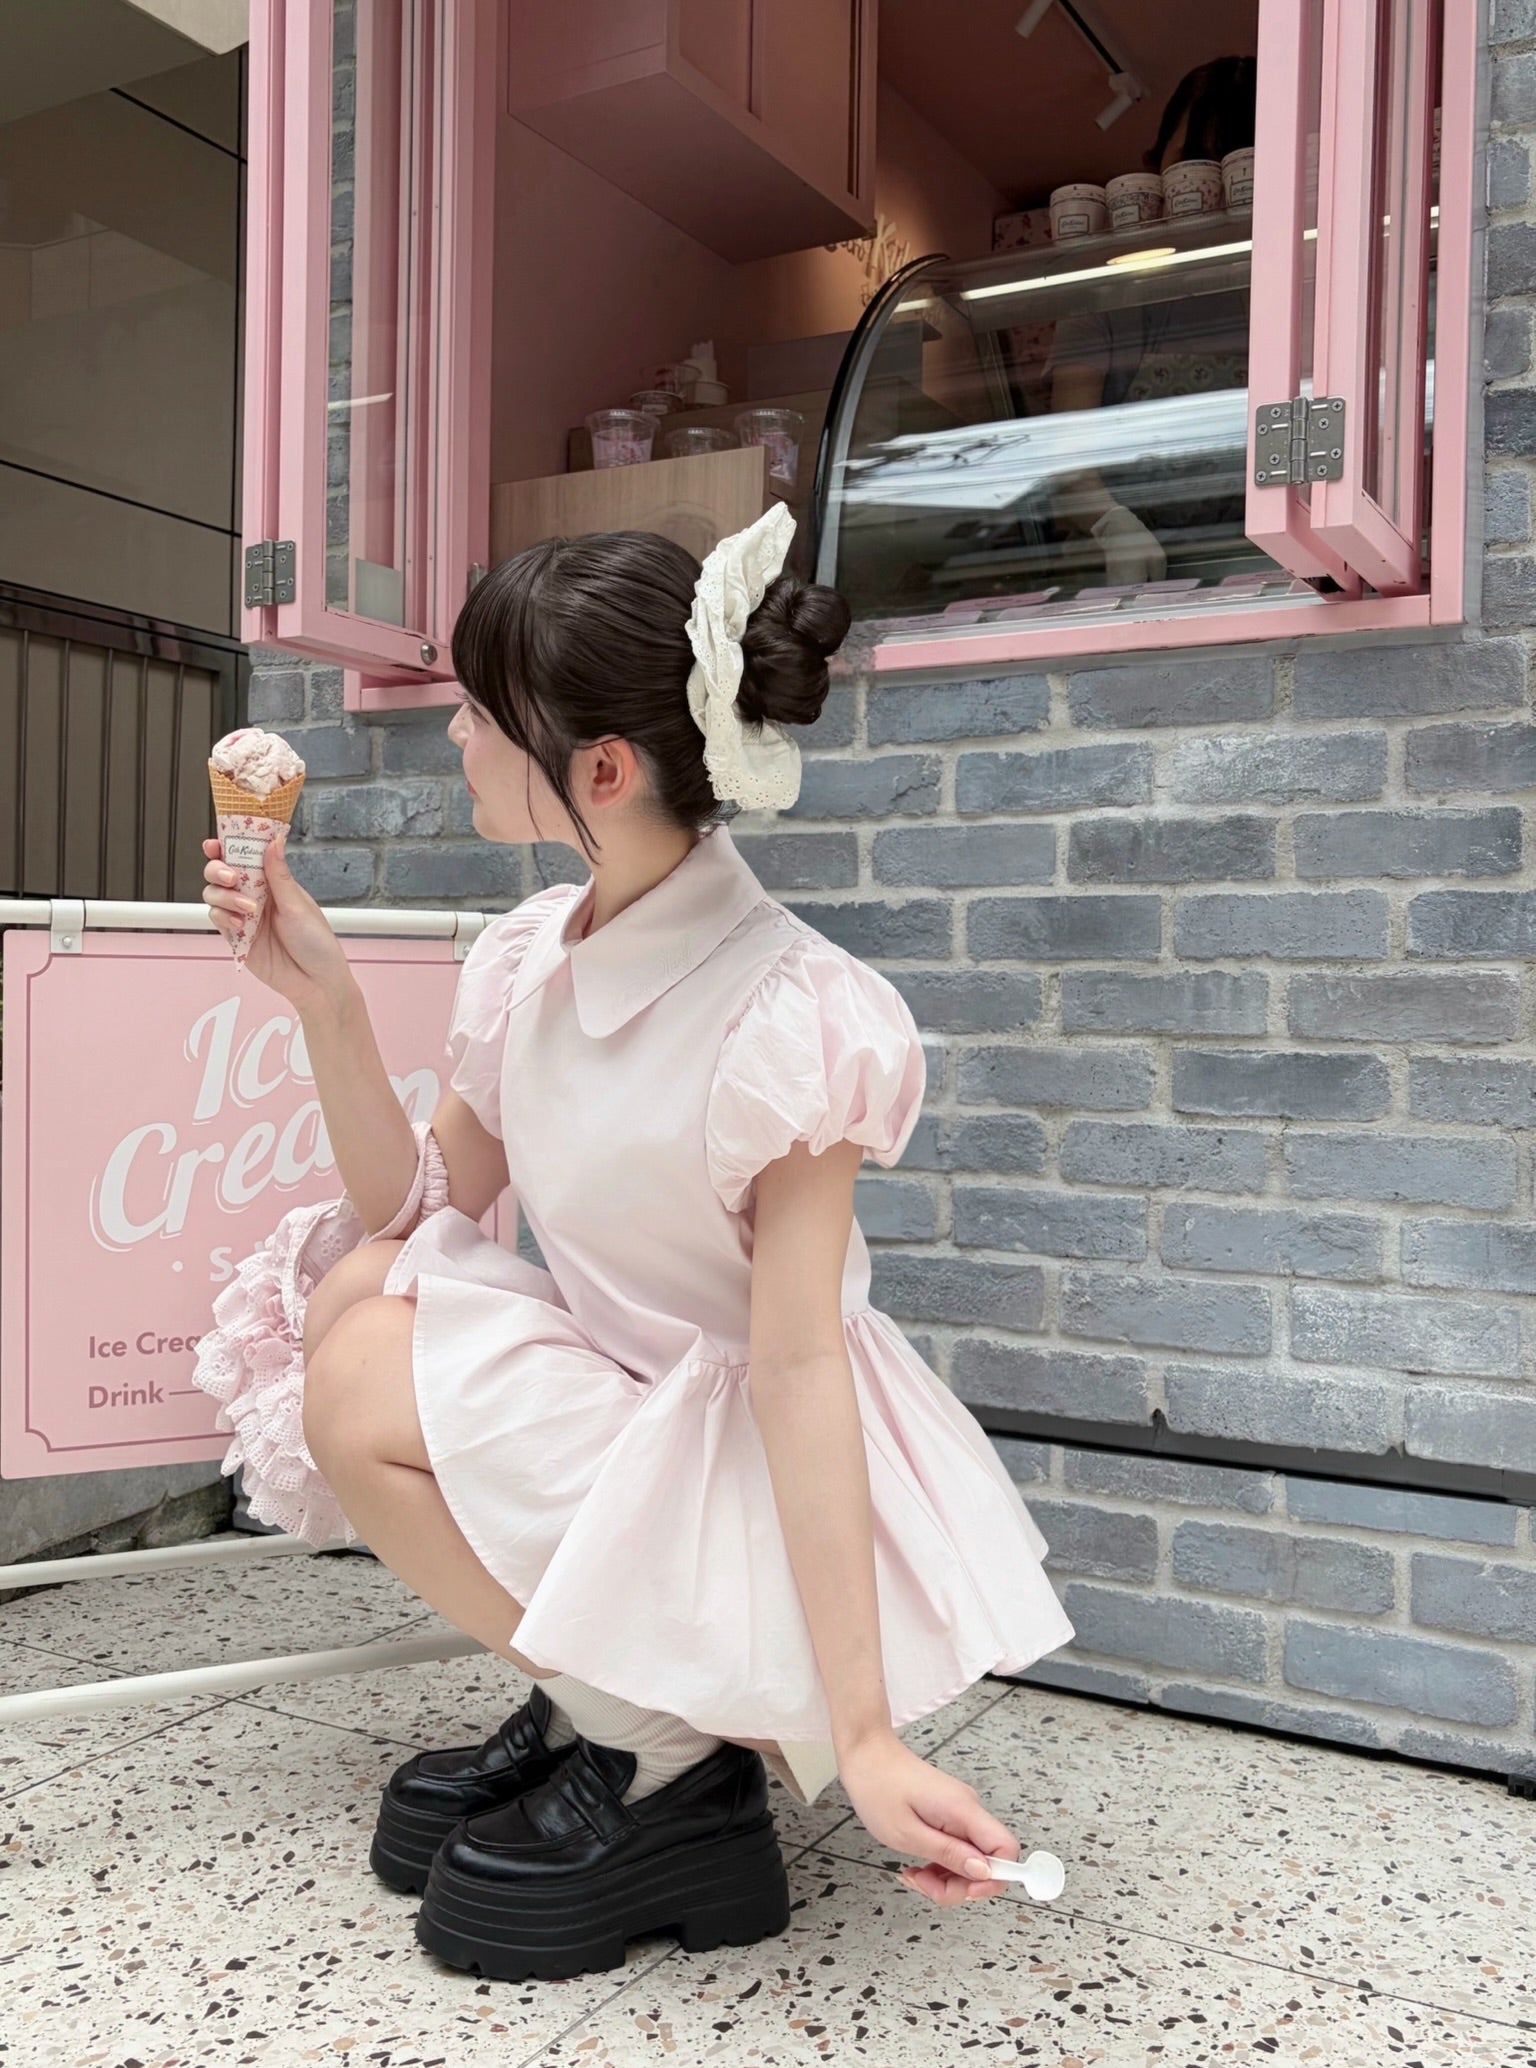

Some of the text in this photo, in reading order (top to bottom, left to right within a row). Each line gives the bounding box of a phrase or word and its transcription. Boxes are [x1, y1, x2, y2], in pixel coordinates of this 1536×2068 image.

[89, 1332, 202, 1359] Ice Crea
[88, 1381, 165, 1409] Drink
